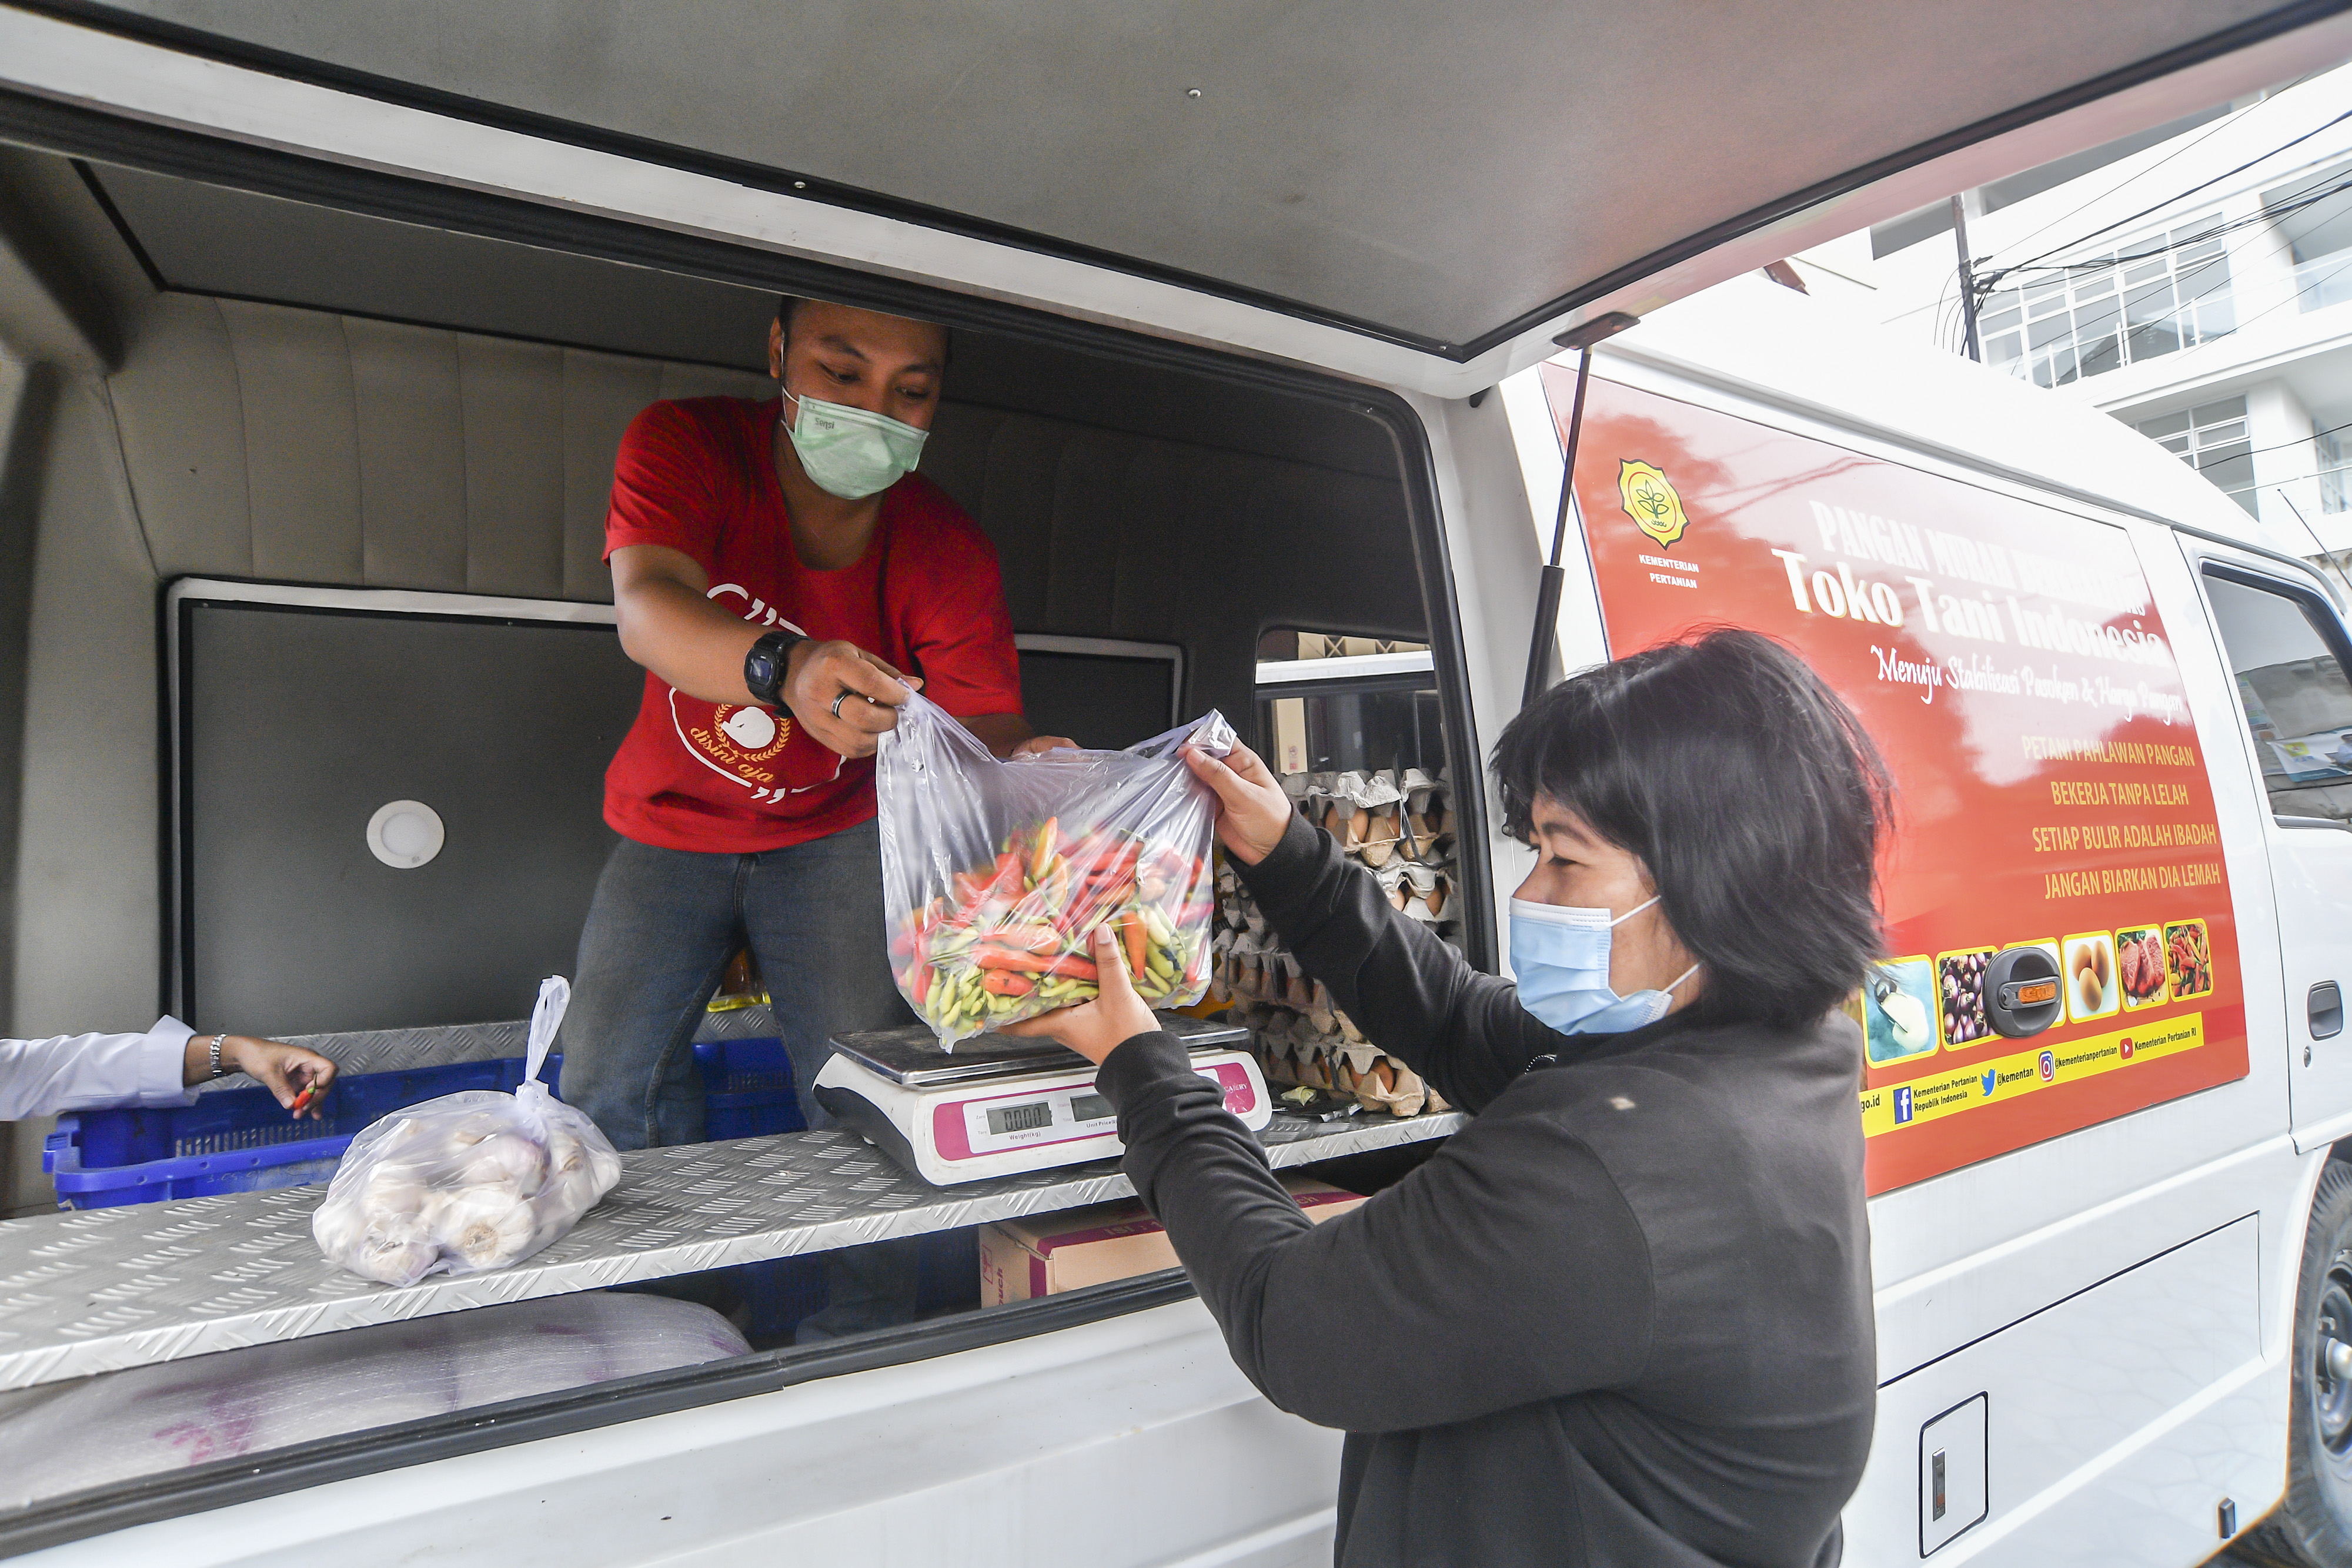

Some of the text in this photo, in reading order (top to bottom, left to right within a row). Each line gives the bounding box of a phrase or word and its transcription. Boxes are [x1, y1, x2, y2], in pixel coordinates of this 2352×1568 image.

[1809, 500, 1930, 572] PANGAN
[1924, 528, 2018, 591] MURAH
[1638, 554, 1699, 573] KEMENTERIAN
[1649, 572, 1698, 589] PERTANIAN
[1770, 548, 2172, 668] Toko Tani Indonesia
[1870, 644, 2183, 726] Menuju Stabilisasi Pasokan & Harga Pangan
[690, 727, 775, 783] disini aja
[2022, 735, 2196, 767] PETANI PAHLAWAN PANGAN
[2050, 781, 2189, 805] BEKERJA TANPA LELAH
[2032, 824, 2217, 852] SETIAP BULIR ADALAH IBADAH
[2044, 863, 2221, 900] JANGAN BIARKAN DIA LEMAH
[2134, 1027, 2197, 1051] Kementerian Pertanian RI
[2054, 1046, 2117, 1069] @kementerianpertanian
[1913, 1075, 1978, 1099] Kementerian Pertanian
[1997, 1068, 2034, 1086] @kementan
[1860, 1094, 1880, 1112] go.id
[1914, 1090, 1968, 1112] Republik Indonesia
[1004, 1107, 1043, 1131] 0000
[1009, 1131, 1041, 1141] Weight(kg)
